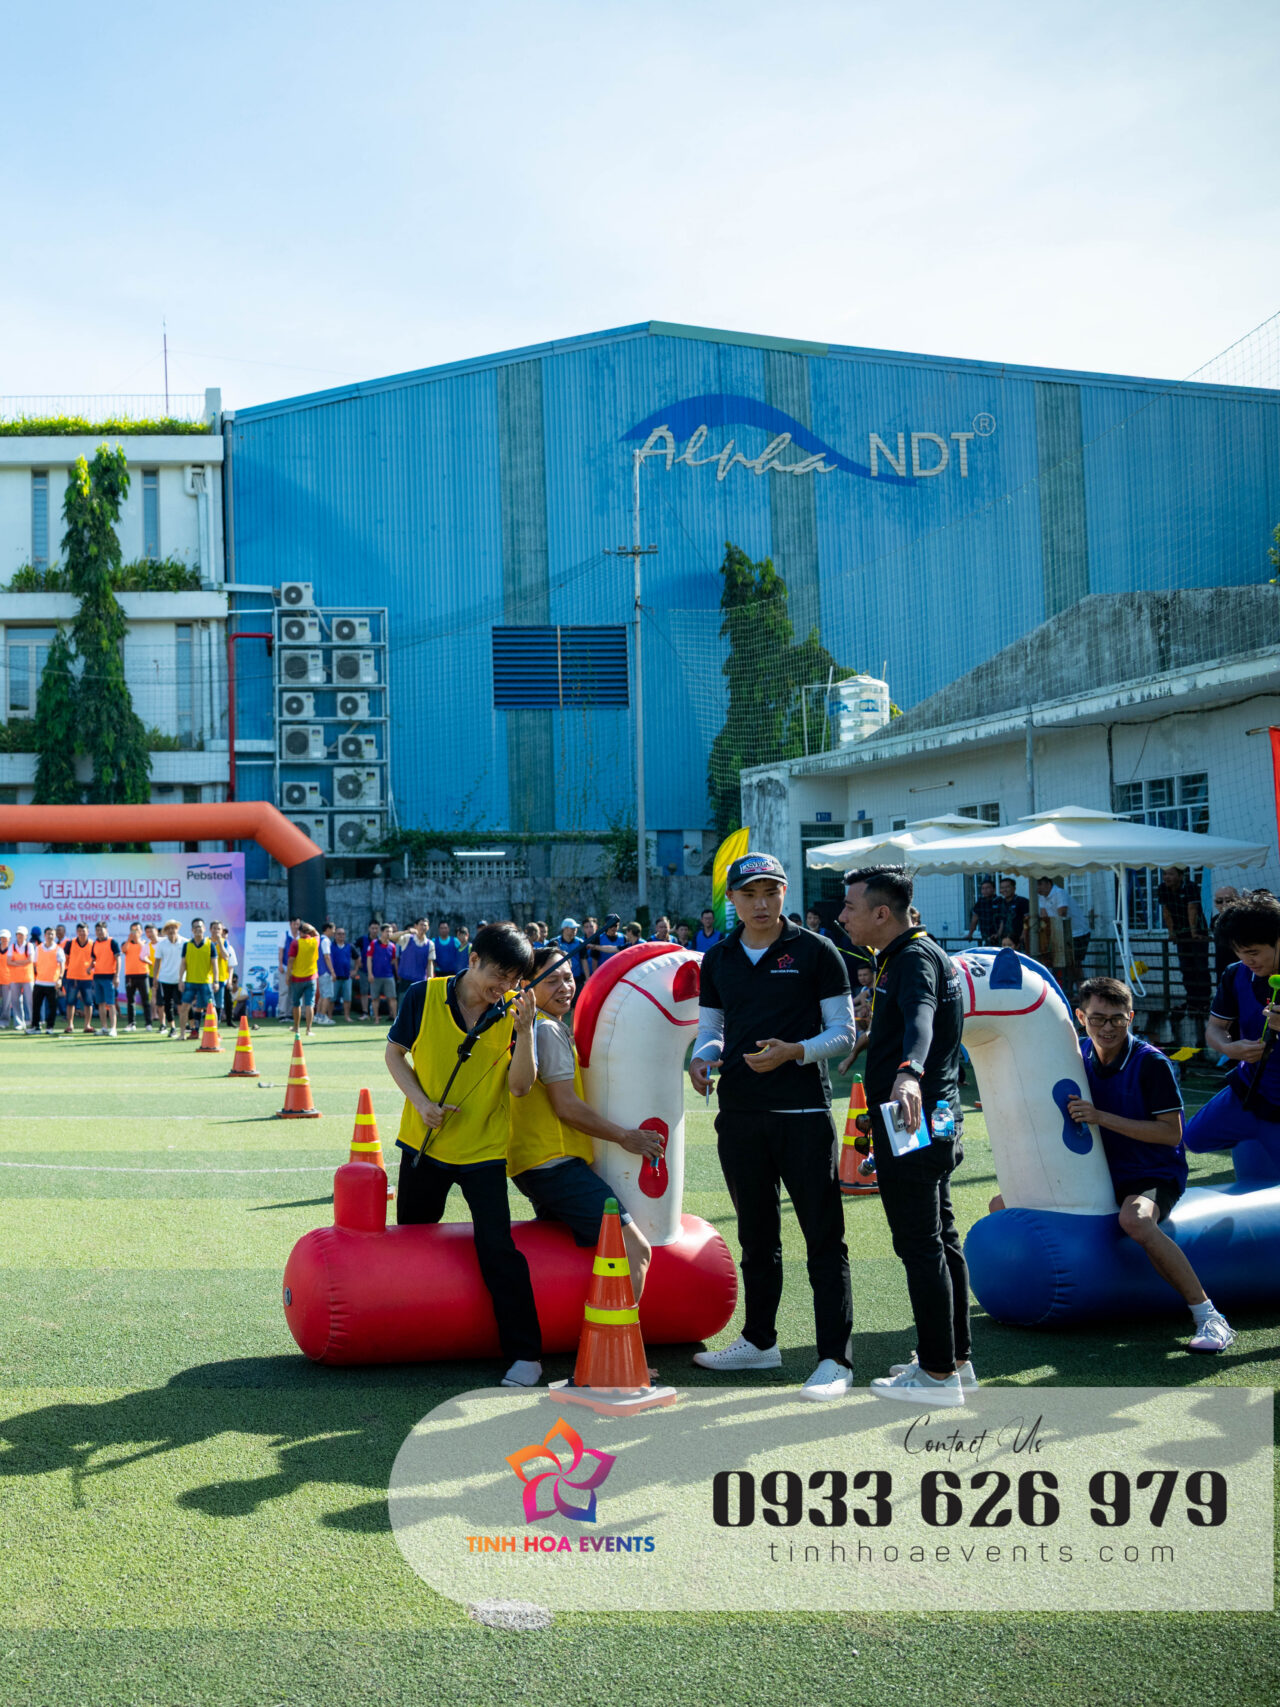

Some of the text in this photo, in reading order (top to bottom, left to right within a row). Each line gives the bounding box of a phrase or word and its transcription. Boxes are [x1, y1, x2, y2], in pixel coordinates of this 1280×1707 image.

[638, 424, 838, 482] Alpha
[868, 432, 975, 478] NDT
[186, 870, 233, 881] Pebsteel
[39, 879, 181, 899] TEAMBUILDING
[9, 901, 27, 913] HỘI
[29, 902, 54, 911] THAO
[56, 900, 76, 911] CÁC
[77, 900, 105, 911] CÔNG
[100, 913, 111, 921] IX
[141, 913, 162, 921] 2025
